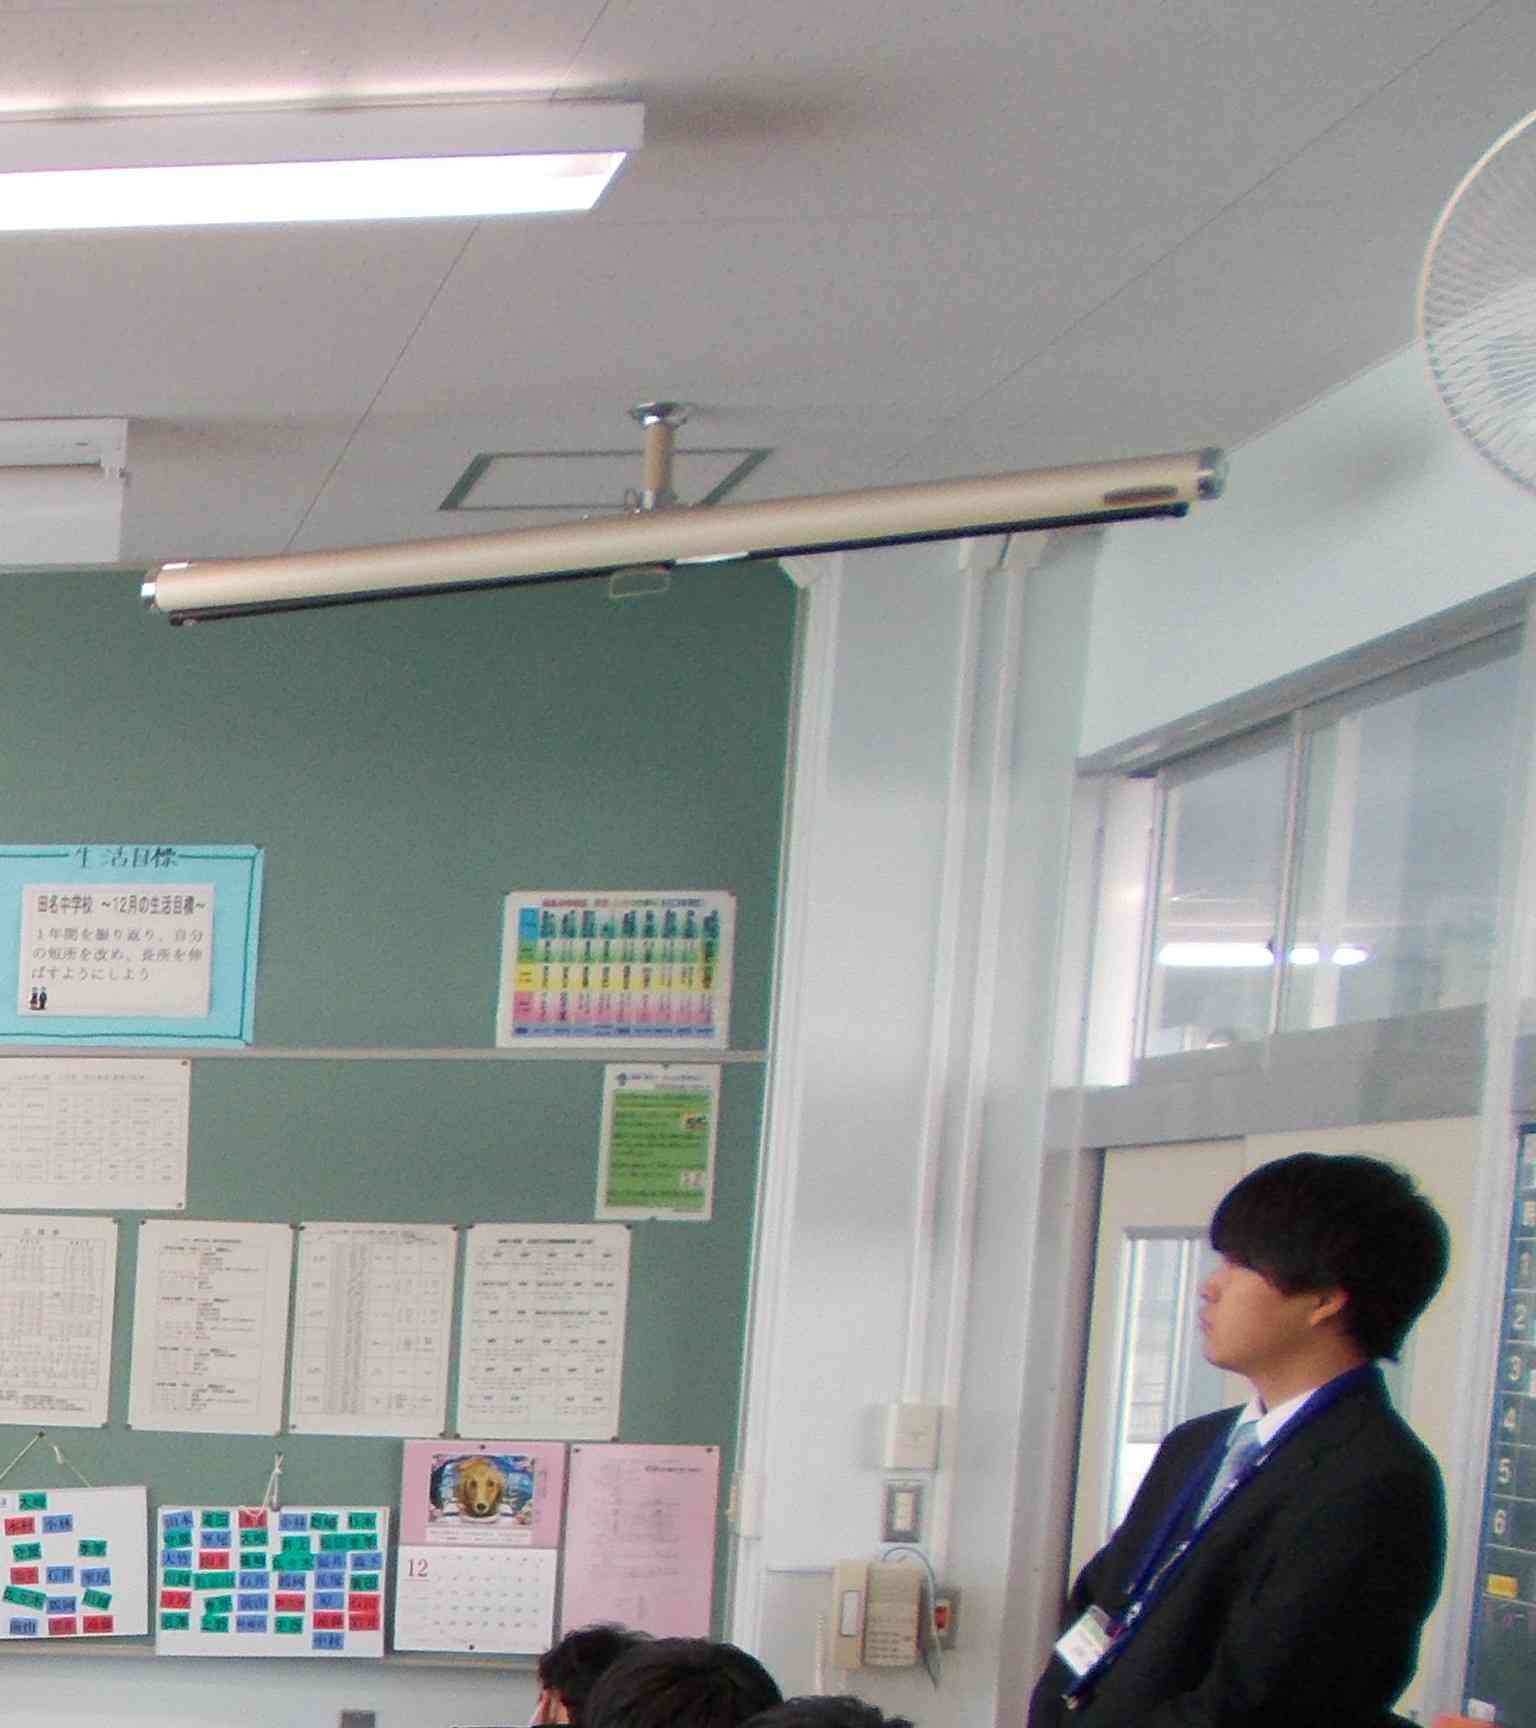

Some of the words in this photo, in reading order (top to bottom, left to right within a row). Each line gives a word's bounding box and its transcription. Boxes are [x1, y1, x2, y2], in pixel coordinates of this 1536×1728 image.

[31, 967, 151, 981] ばすようにしよう
[1512, 1303, 1528, 1331] 2
[1507, 1355, 1522, 1382] 3
[1503, 1407, 1518, 1432] 4
[1498, 1457, 1513, 1484] 5
[1493, 1509, 1507, 1536] 6
[407, 1558, 429, 1578] 12
